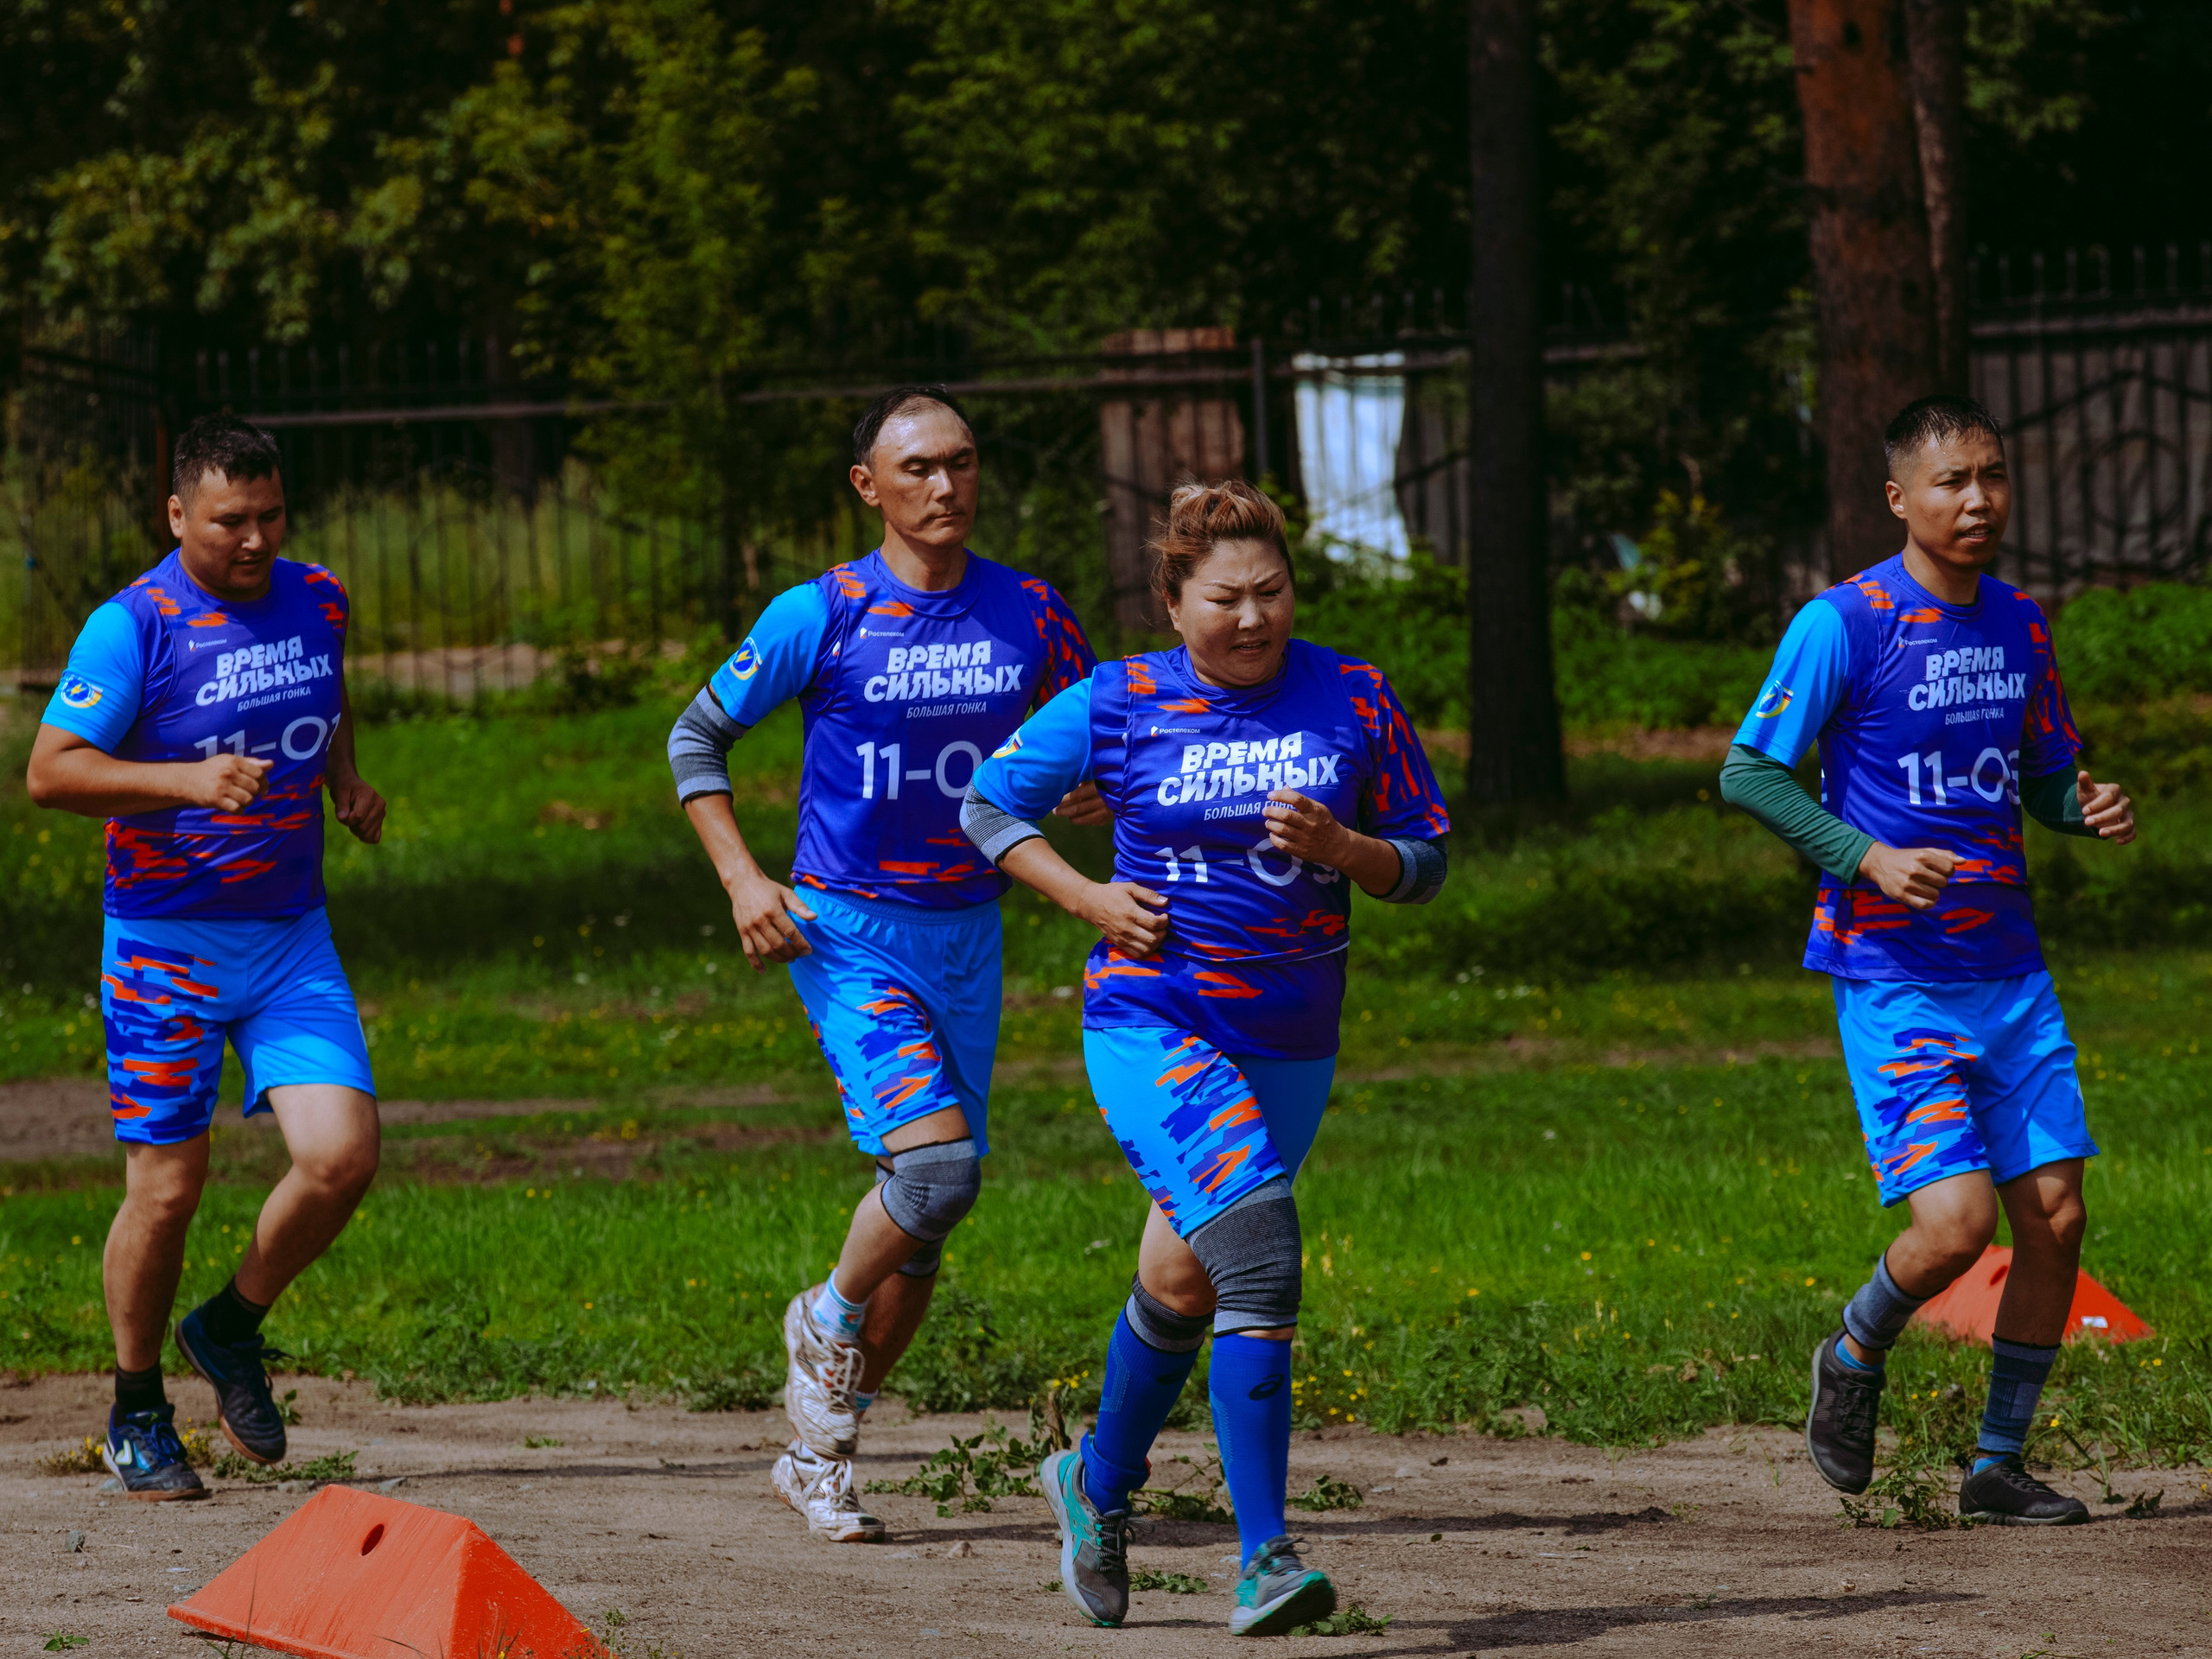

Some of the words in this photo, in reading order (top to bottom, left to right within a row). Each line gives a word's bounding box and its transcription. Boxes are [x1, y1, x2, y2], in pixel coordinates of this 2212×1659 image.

[216, 635, 303, 679] ВРЕМЯ
[886, 640, 992, 674] ВРЕМЯ
[1925, 646, 2005, 681] ВРЕМЯ
[194, 654, 334, 707] СИЛЬНЫХ
[864, 664, 1024, 702] СИЛЬНЫХ
[1908, 672, 2026, 711] СИЛЬНЫХ
[237, 693, 281, 712] БОЛЬШАЯ
[282, 686, 312, 702] ГОНКА
[906, 703, 954, 719] БОЛЬШАЯ
[955, 701, 987, 715] ГОНКА
[1944, 710, 1980, 726] БОЛЬШАЯ
[1981, 708, 2005, 722] ГОНКА
[1180, 732, 1303, 774] ВРЕМЯ
[1156, 754, 1340, 807] СИЛЬНЫХ
[1204, 801, 1262, 821] БОЛЬШАЯ
